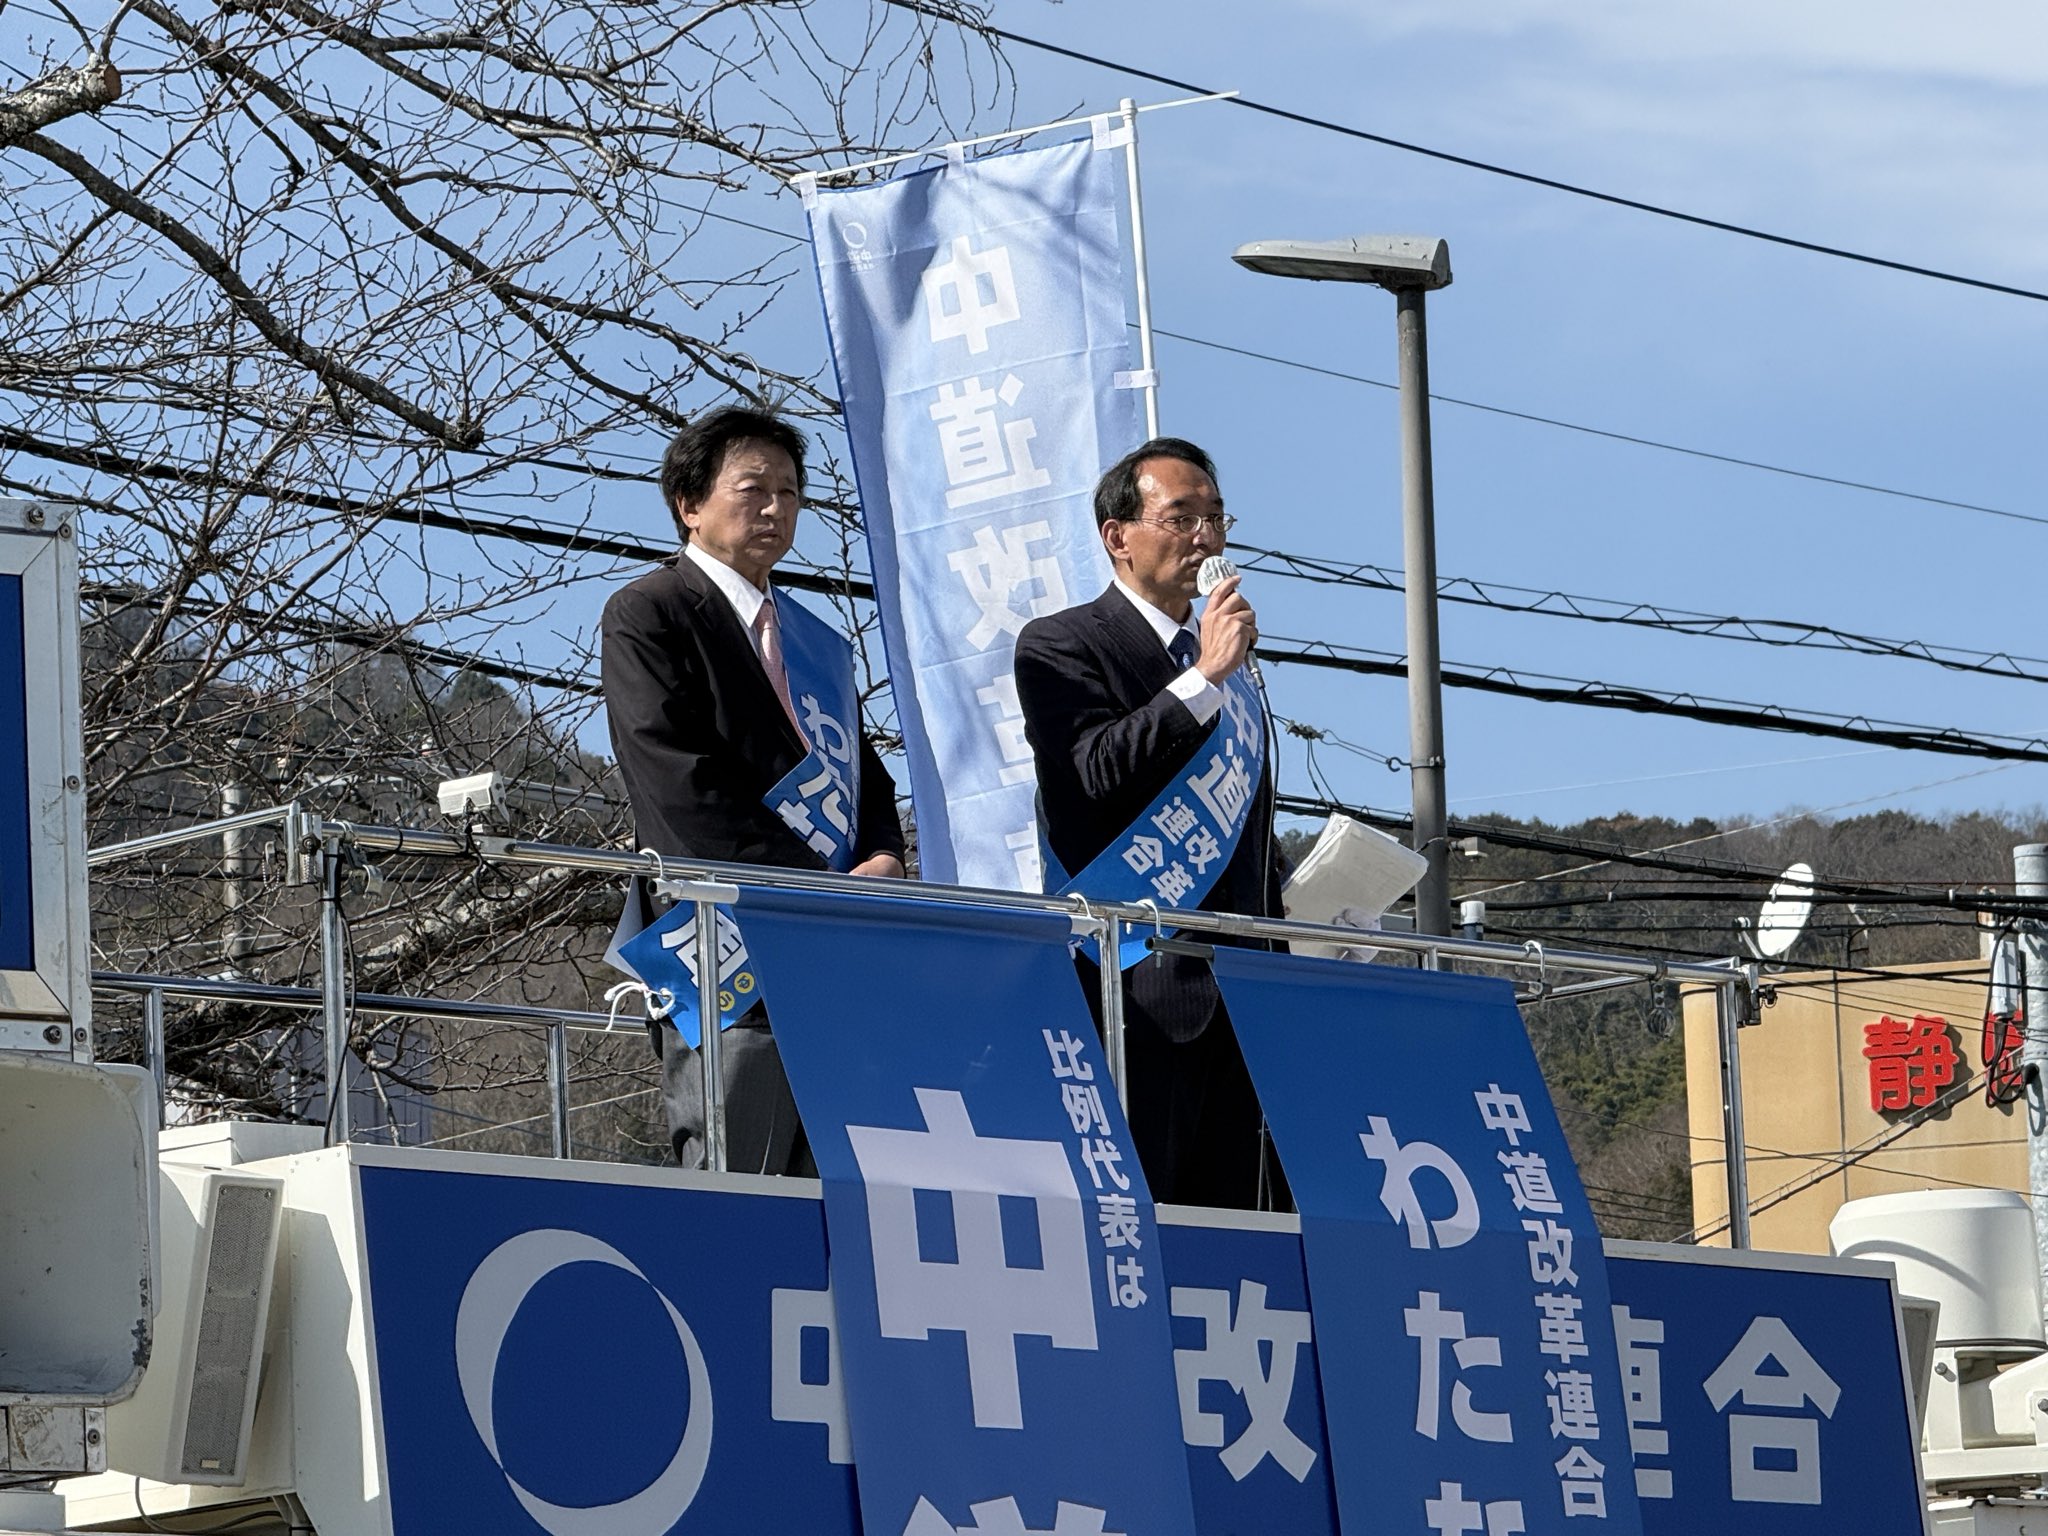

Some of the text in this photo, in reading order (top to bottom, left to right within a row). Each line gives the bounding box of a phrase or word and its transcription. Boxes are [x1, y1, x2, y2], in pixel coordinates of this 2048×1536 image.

[1186, 680, 1259, 839] 中道
[845, 1086, 1128, 1536] 中
[1041, 1028, 1148, 1310] 比例代表は
[1473, 1083, 1608, 1519] 中道改革連合
